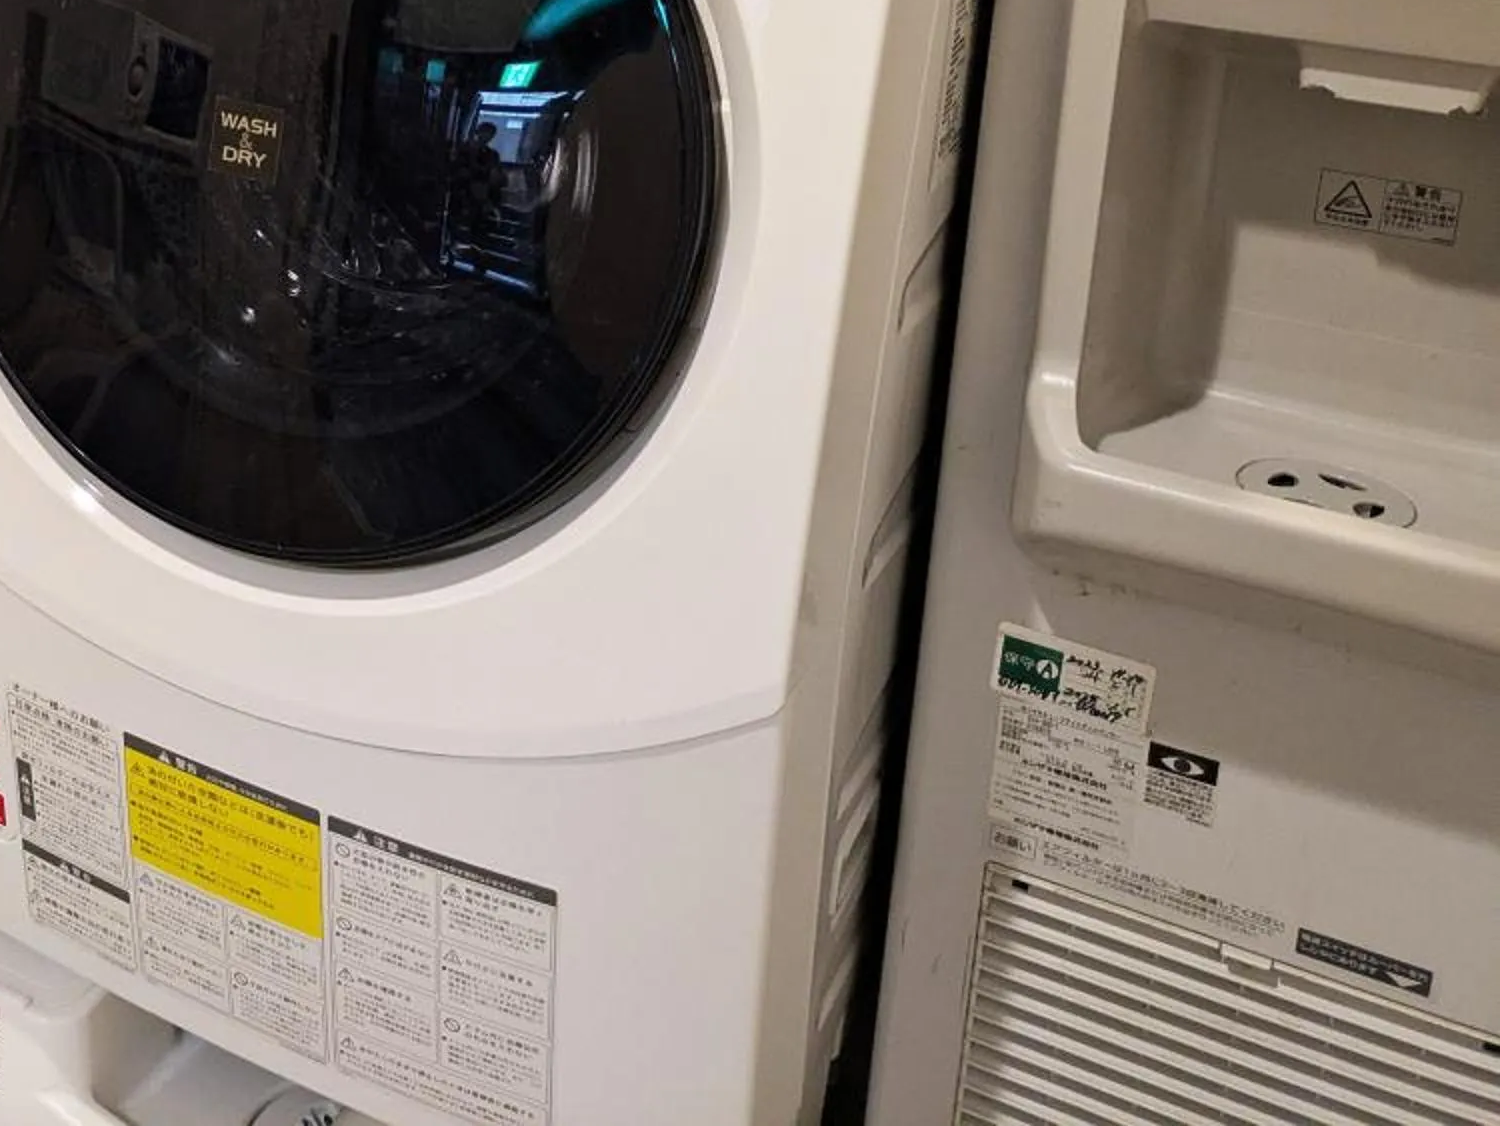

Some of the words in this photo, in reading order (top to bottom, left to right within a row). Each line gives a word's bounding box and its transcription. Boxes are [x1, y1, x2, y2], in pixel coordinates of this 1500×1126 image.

[221, 110, 277, 139] WASH
[239, 132, 253, 151] &
[222, 144, 267, 169] DRY
